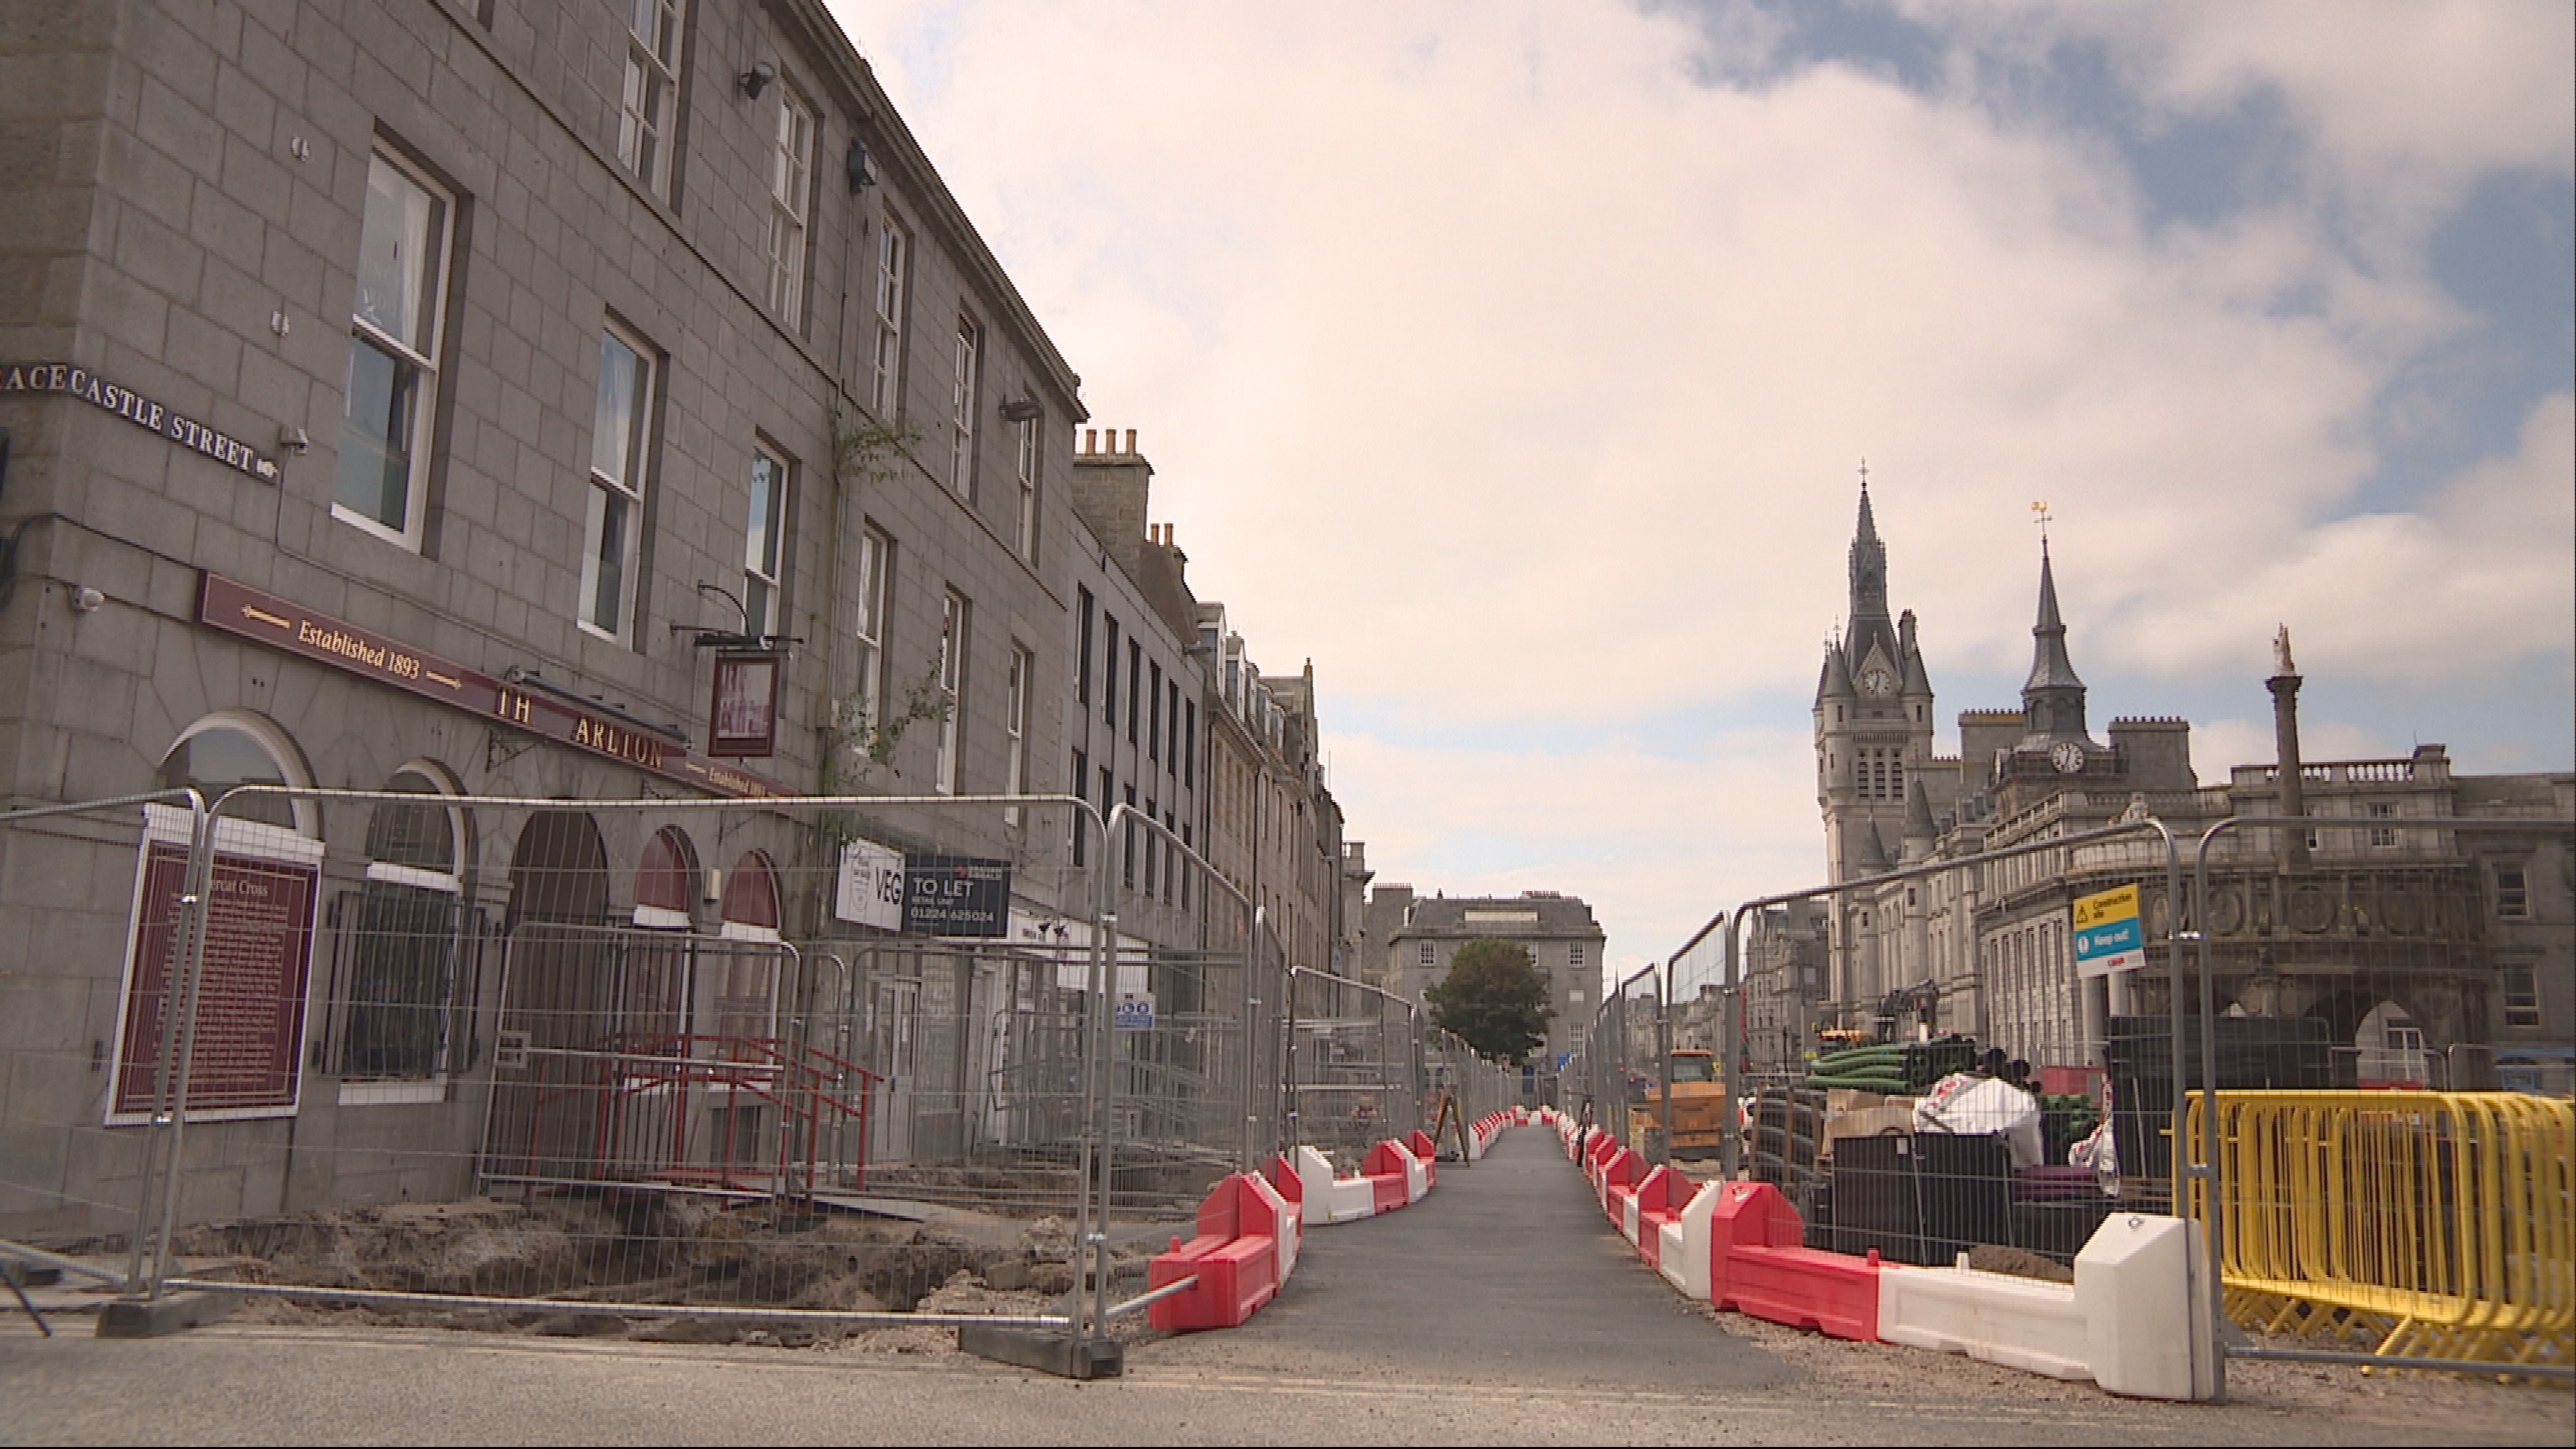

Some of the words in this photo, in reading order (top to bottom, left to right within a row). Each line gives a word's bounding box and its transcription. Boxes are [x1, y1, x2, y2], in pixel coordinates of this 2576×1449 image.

[0, 365, 68, 390] ACE
[70, 369, 163, 431] CASTLE
[170, 415, 254, 471] STREET
[299, 619, 386, 668] Established
[387, 651, 421, 680] 1893
[211, 879, 236, 892] ercat
[238, 879, 269, 897] Cross
[875, 866, 902, 905] VEG
[913, 877, 938, 895] TO
[943, 879, 975, 897] LET
[910, 906, 947, 919] 01224
[2093, 893, 2133, 910] Construction
